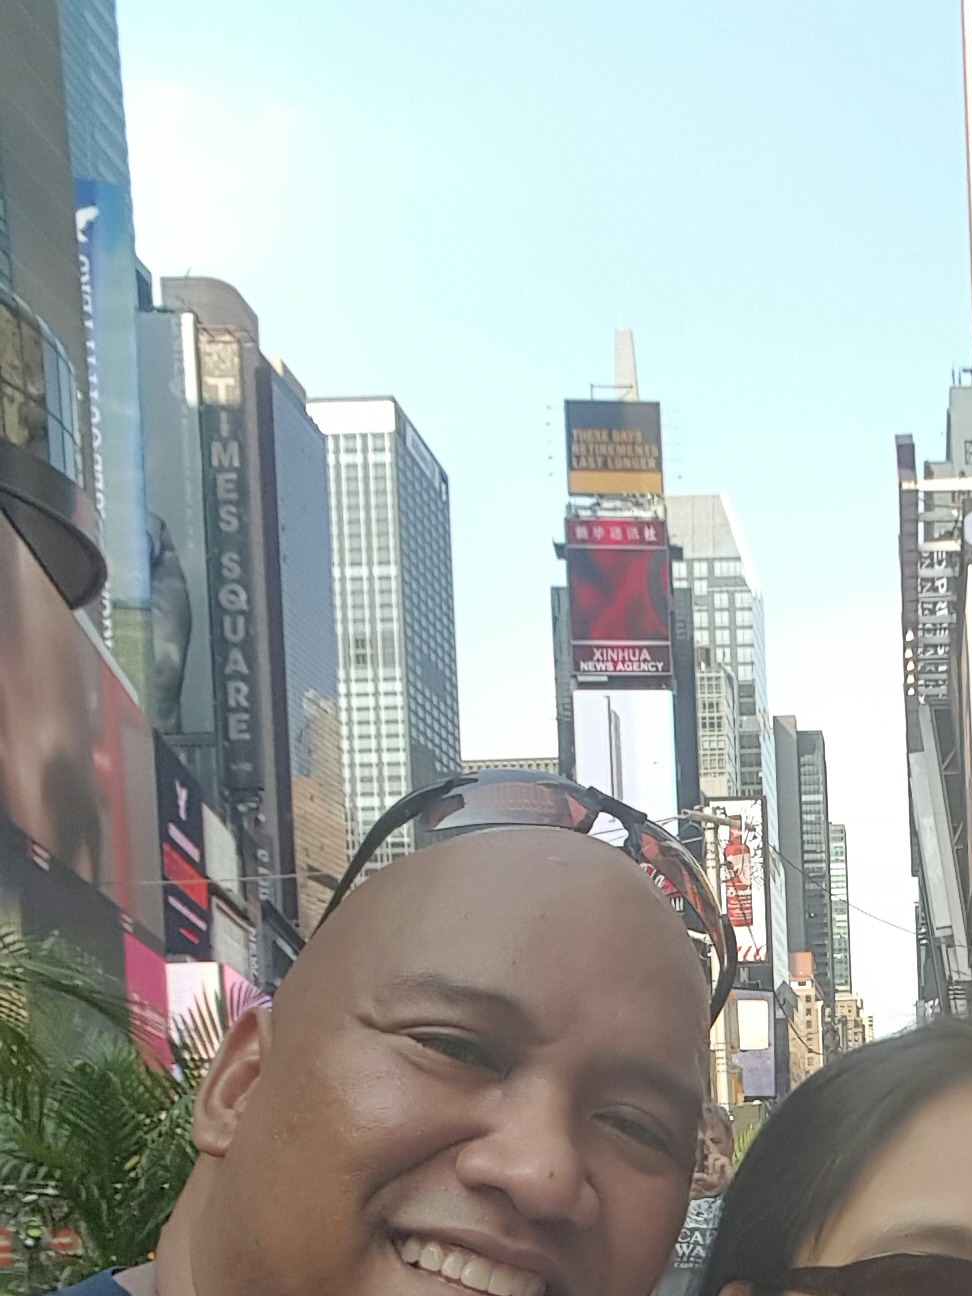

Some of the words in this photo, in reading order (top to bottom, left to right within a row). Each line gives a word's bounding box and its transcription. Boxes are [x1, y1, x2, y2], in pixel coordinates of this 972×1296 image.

[204, 376, 240, 533] TIMES
[218, 552, 251, 740] SQUARE
[580, 661, 614, 671] NEWS
[616, 661, 664, 672] AGENCY
[593, 647, 652, 661] XINHUA
